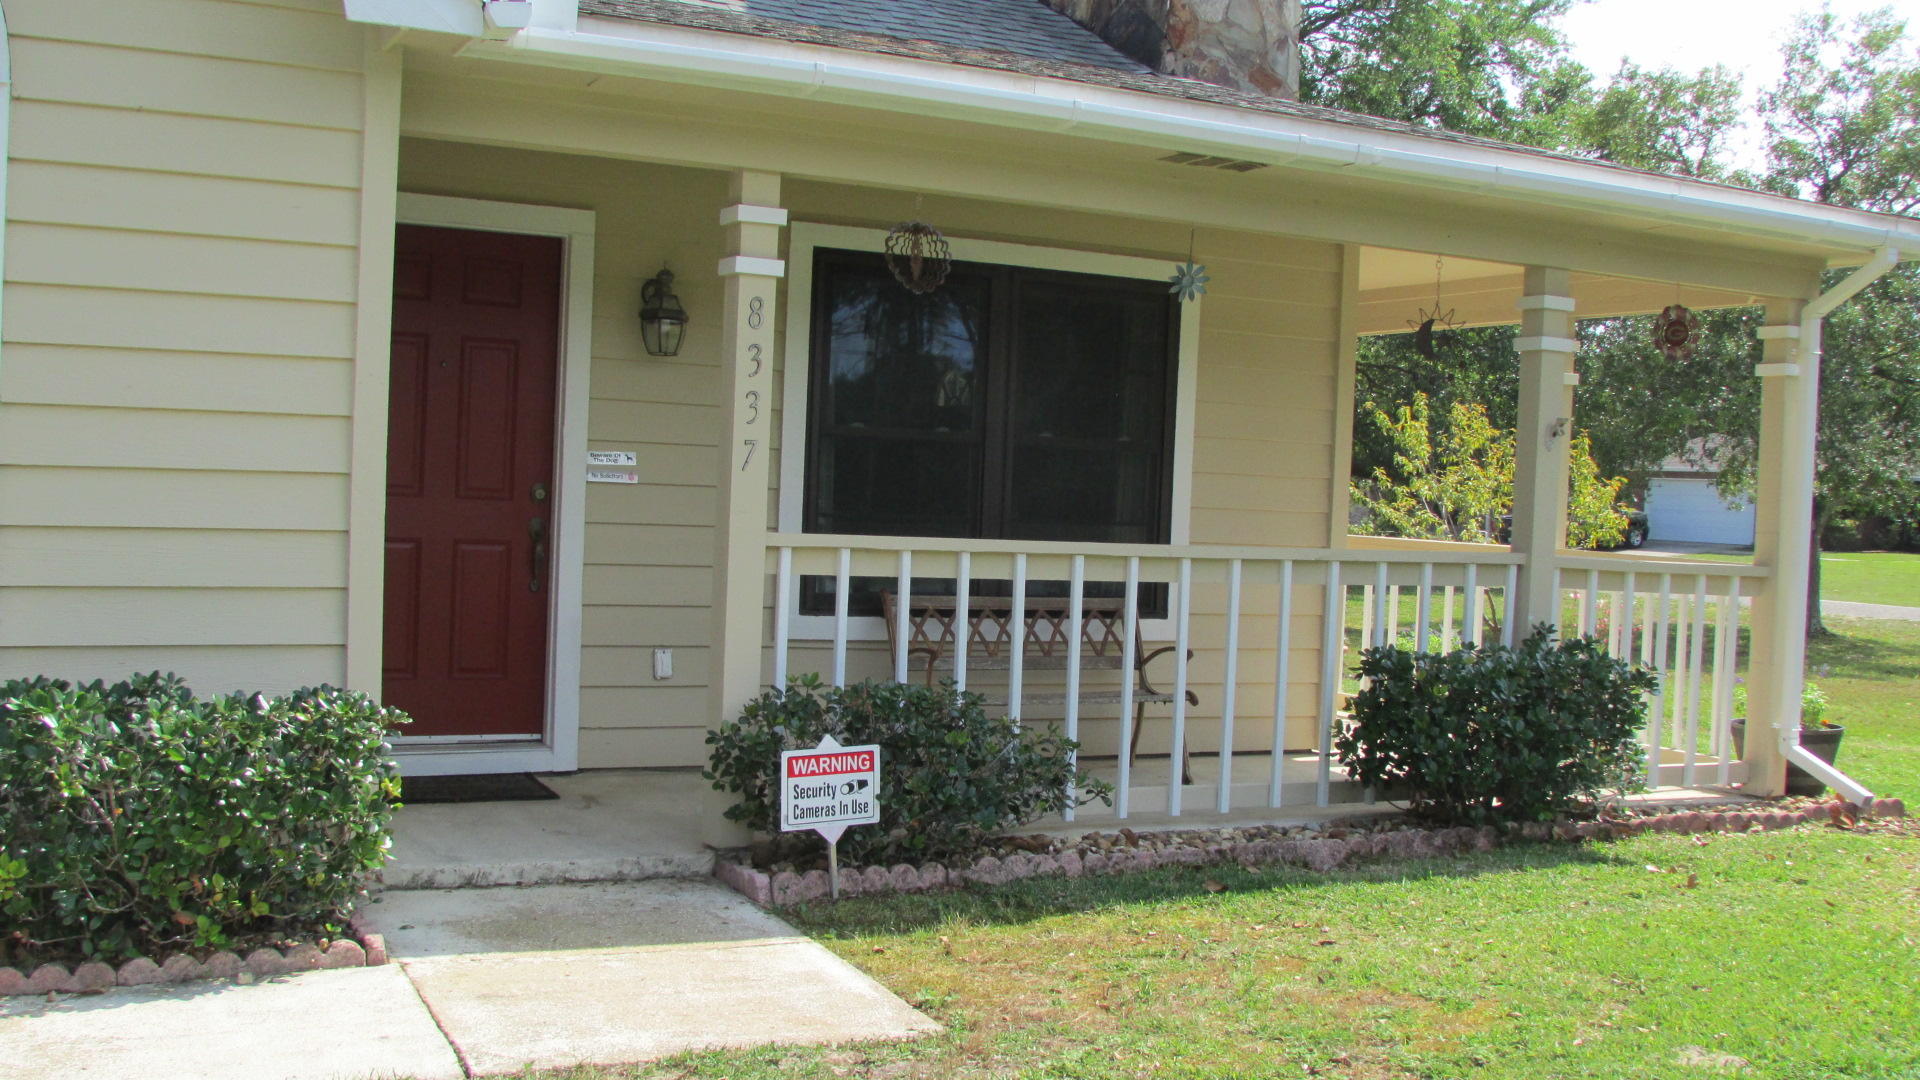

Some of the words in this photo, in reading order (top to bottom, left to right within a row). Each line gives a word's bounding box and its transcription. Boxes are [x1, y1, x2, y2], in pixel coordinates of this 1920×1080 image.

[741, 296, 763, 471] 8337
[792, 754, 870, 775] WARNING
[793, 782, 837, 800] Security
[793, 804, 836, 820] Cameras
[840, 801, 849, 815] In
[851, 799, 869, 815] Use
